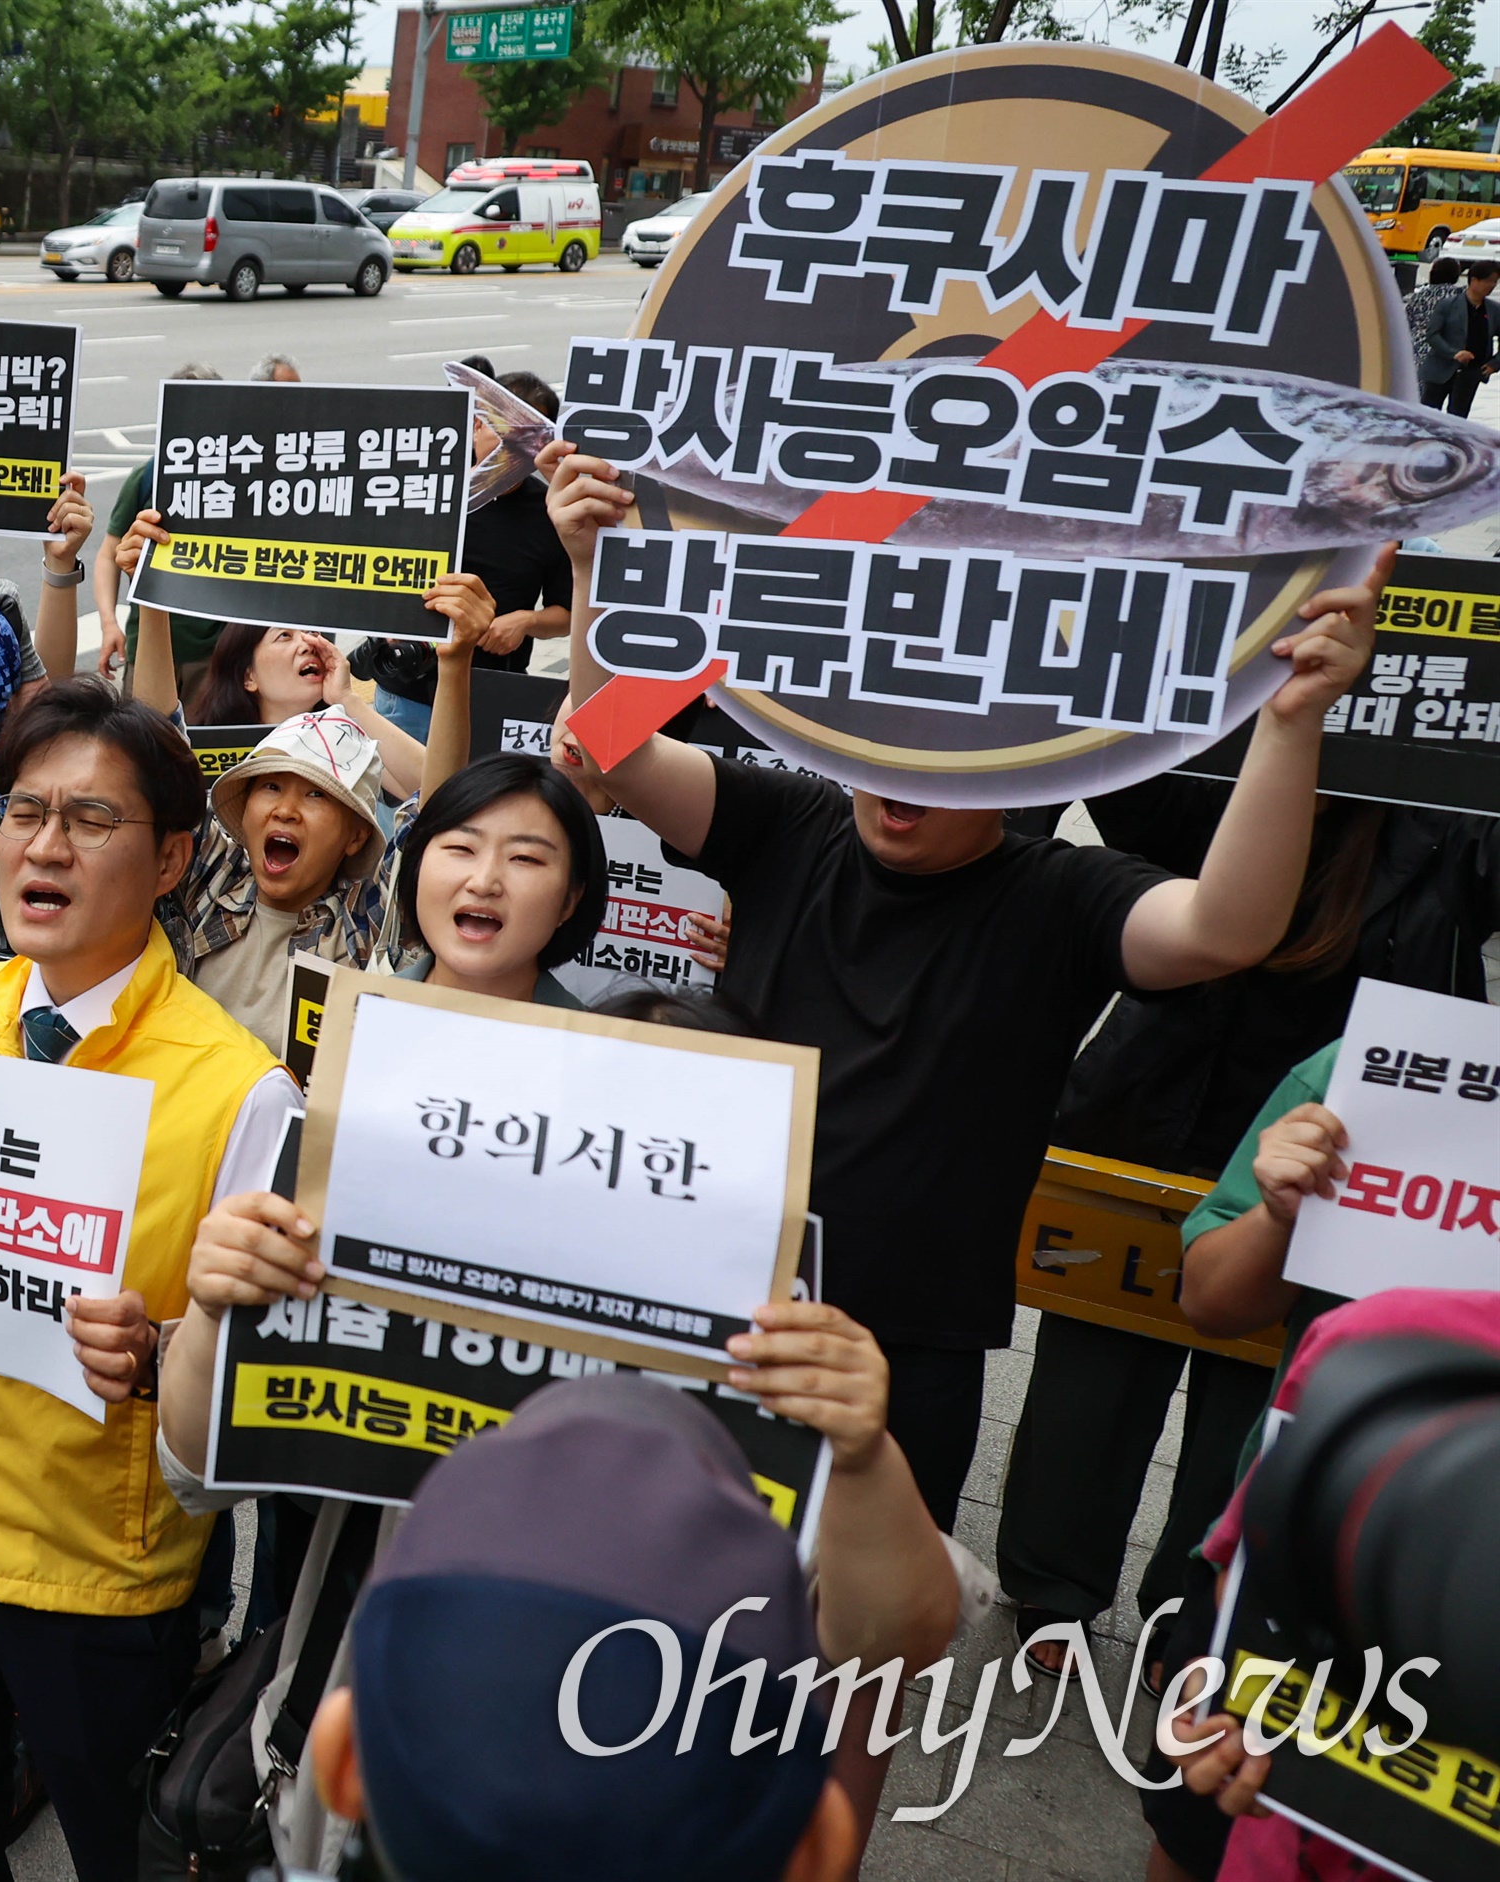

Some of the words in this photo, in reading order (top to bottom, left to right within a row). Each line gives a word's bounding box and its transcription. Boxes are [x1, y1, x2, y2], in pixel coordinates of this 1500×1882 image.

[1376, 167, 1396, 176] BUS
[740, 157, 1308, 340] 후쿠시마
[164, 434, 264, 474] 오염수
[276, 430, 345, 472] 방류
[359, 426, 458, 470] 임박?
[560, 342, 1303, 530] 방사능오염수
[167, 480, 235, 519] 세슘
[248, 476, 353, 516] 180배
[364, 473, 454, 516] 우럭!
[171, 541, 248, 573] 방사능
[255, 547, 309, 580] 밥상
[314, 551, 366, 585] 절대
[373, 555, 438, 589] 안돼!
[592, 536, 1242, 730] 방류반대!
[1370, 654, 1469, 698] 방류
[1361, 1045, 1451, 1095] 일본
[415, 1096, 711, 1203] 항의서한
[367, 1247, 405, 1271] 일본
[406, 1255, 461, 1283] 방사성
[463, 1269, 518, 1297] 오염수
[519, 1279, 593, 1313] 해양투기
[594, 1297, 634, 1322] 저지
[634, 1307, 713, 1339] 서울행동
[265, 1376, 412, 1438] 방사능
